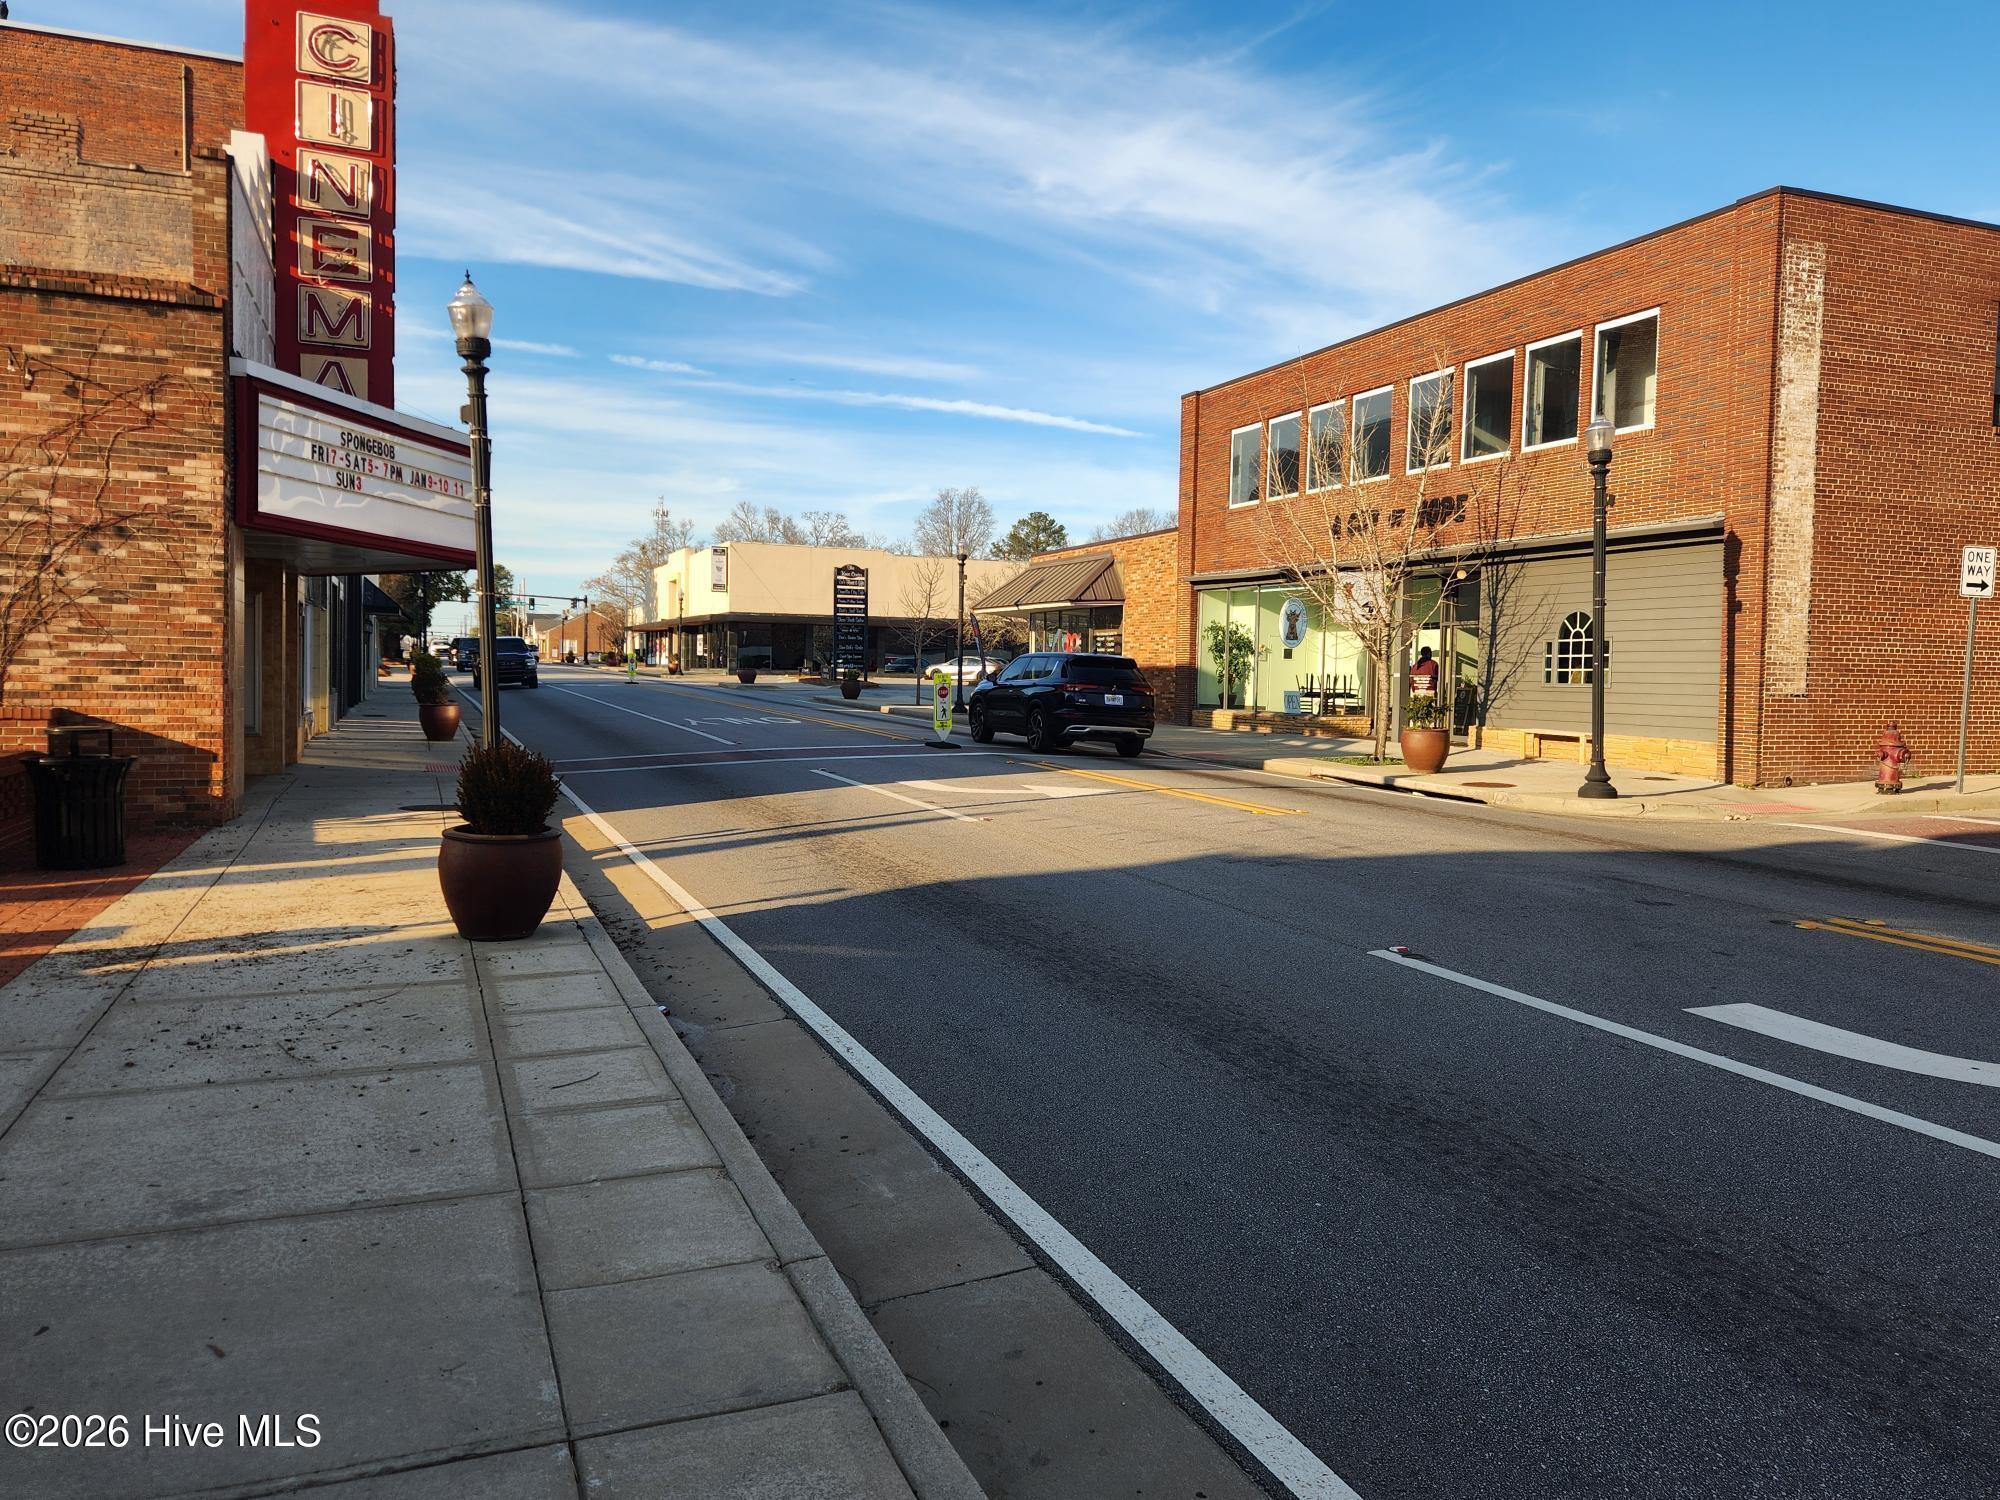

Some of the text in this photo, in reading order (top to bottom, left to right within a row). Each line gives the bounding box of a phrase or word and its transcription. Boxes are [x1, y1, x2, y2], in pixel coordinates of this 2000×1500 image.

[308, 22, 365, 398] CINEMA
[340, 431, 396, 460] SPONGEBOB
[336, 471, 362, 492] SUN3
[454, 481, 465, 497] 11
[1967, 551, 1991, 563] ONE
[1967, 565, 1992, 577] WAY
